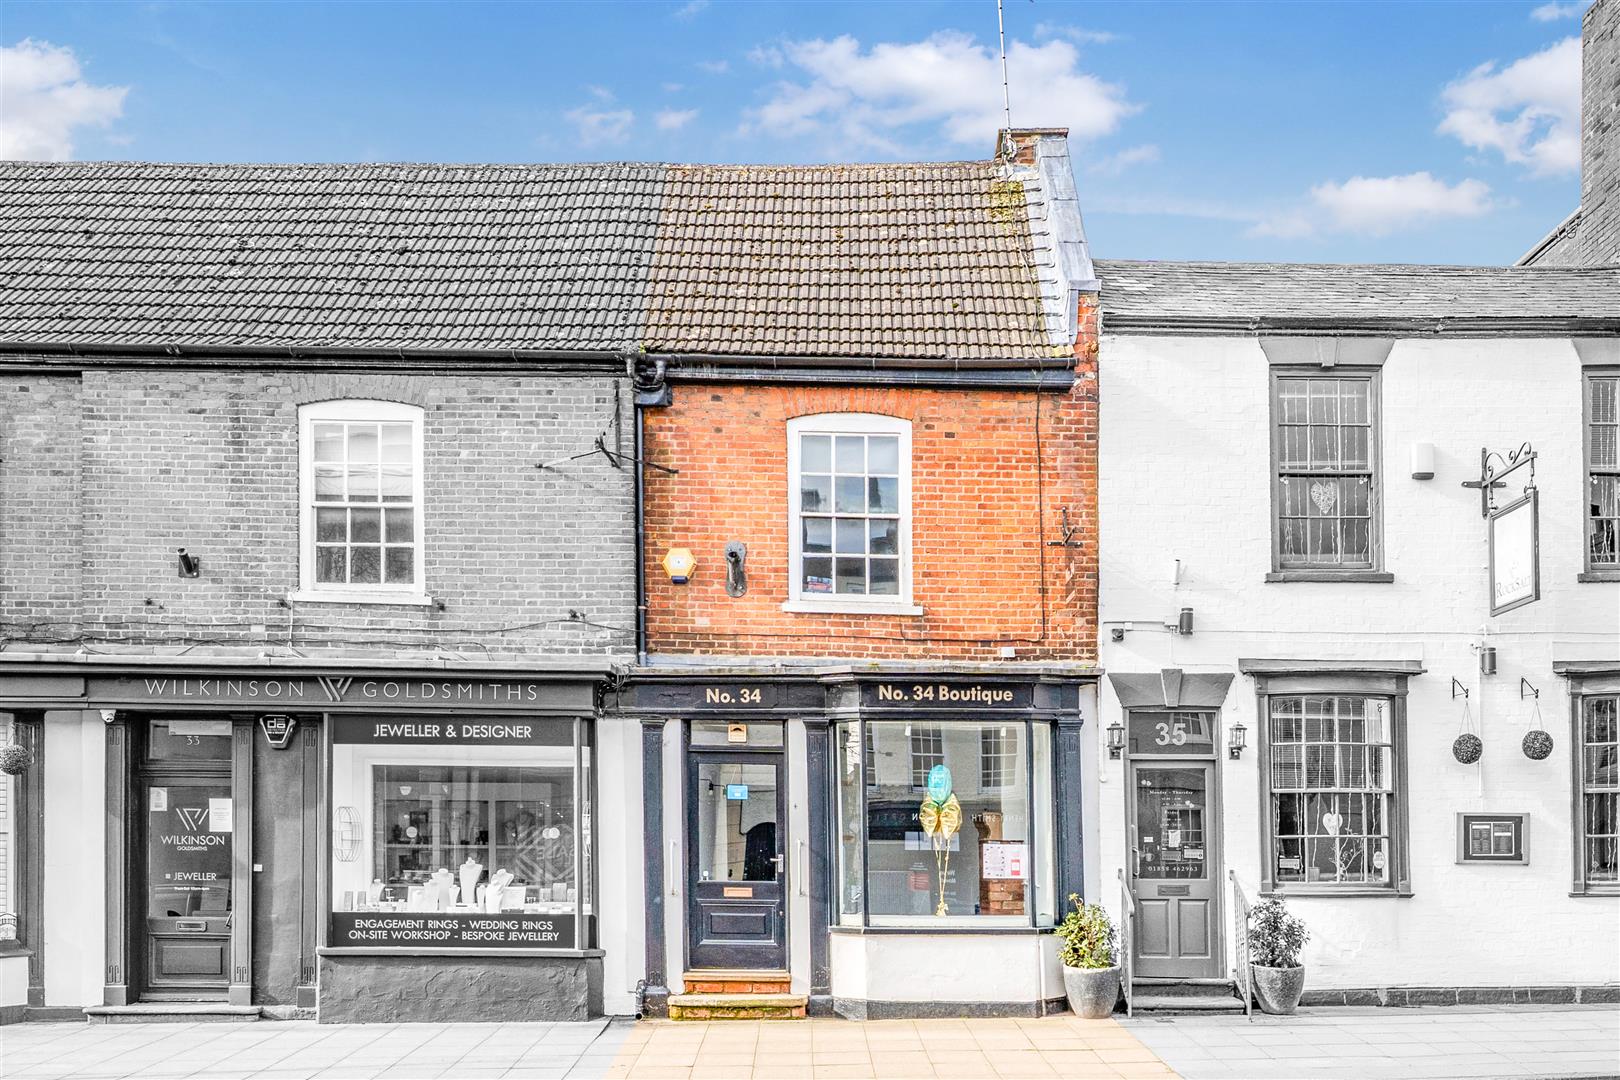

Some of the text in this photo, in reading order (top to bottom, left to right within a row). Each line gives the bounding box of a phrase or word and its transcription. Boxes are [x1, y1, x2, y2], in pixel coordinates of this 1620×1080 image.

[144, 679, 304, 697] WILKINSON
[363, 682, 537, 701] GOLDSMITHS
[706, 688, 762, 703] No. 34
[879, 685, 1014, 705] No. 34 Boutique
[373, 724, 532, 738] JEWELLER & DESIGNER
[1155, 722, 1187, 746] 35
[186, 735, 201, 745] 33
[160, 835, 225, 845] WILKINSON
[173, 871, 217, 880] JEWELLER
[355, 919, 425, 929] ENGAGEMENT
[427, 919, 459, 929] RINGS
[469, 920, 519, 930] WEDDING
[522, 920, 553, 930] RINGS
[348, 930, 388, 940] ON-SITE
[391, 930, 451, 940] WORKSHOP
[461, 931, 505, 940] BESPOKE
[507, 932, 560, 941] JEWELLERY
